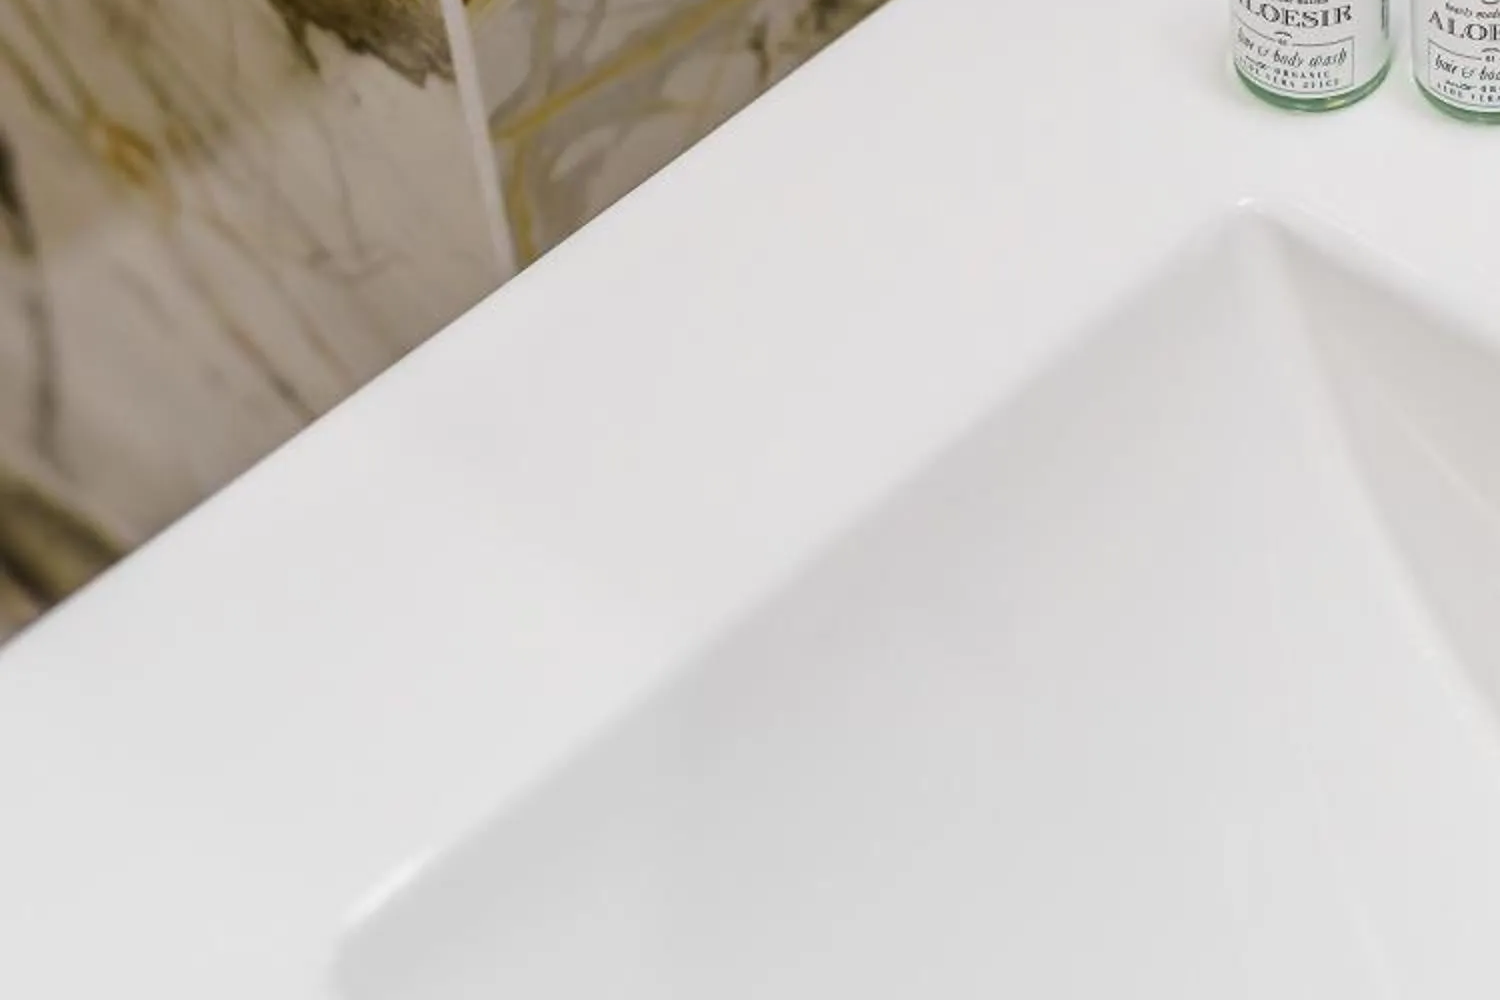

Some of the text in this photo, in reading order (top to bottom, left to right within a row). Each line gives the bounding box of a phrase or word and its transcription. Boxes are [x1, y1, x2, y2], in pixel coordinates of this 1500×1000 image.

[1273, 48, 1304, 68] body
[1309, 47, 1348, 68] wash
[1434, 54, 1458, 75] hair
